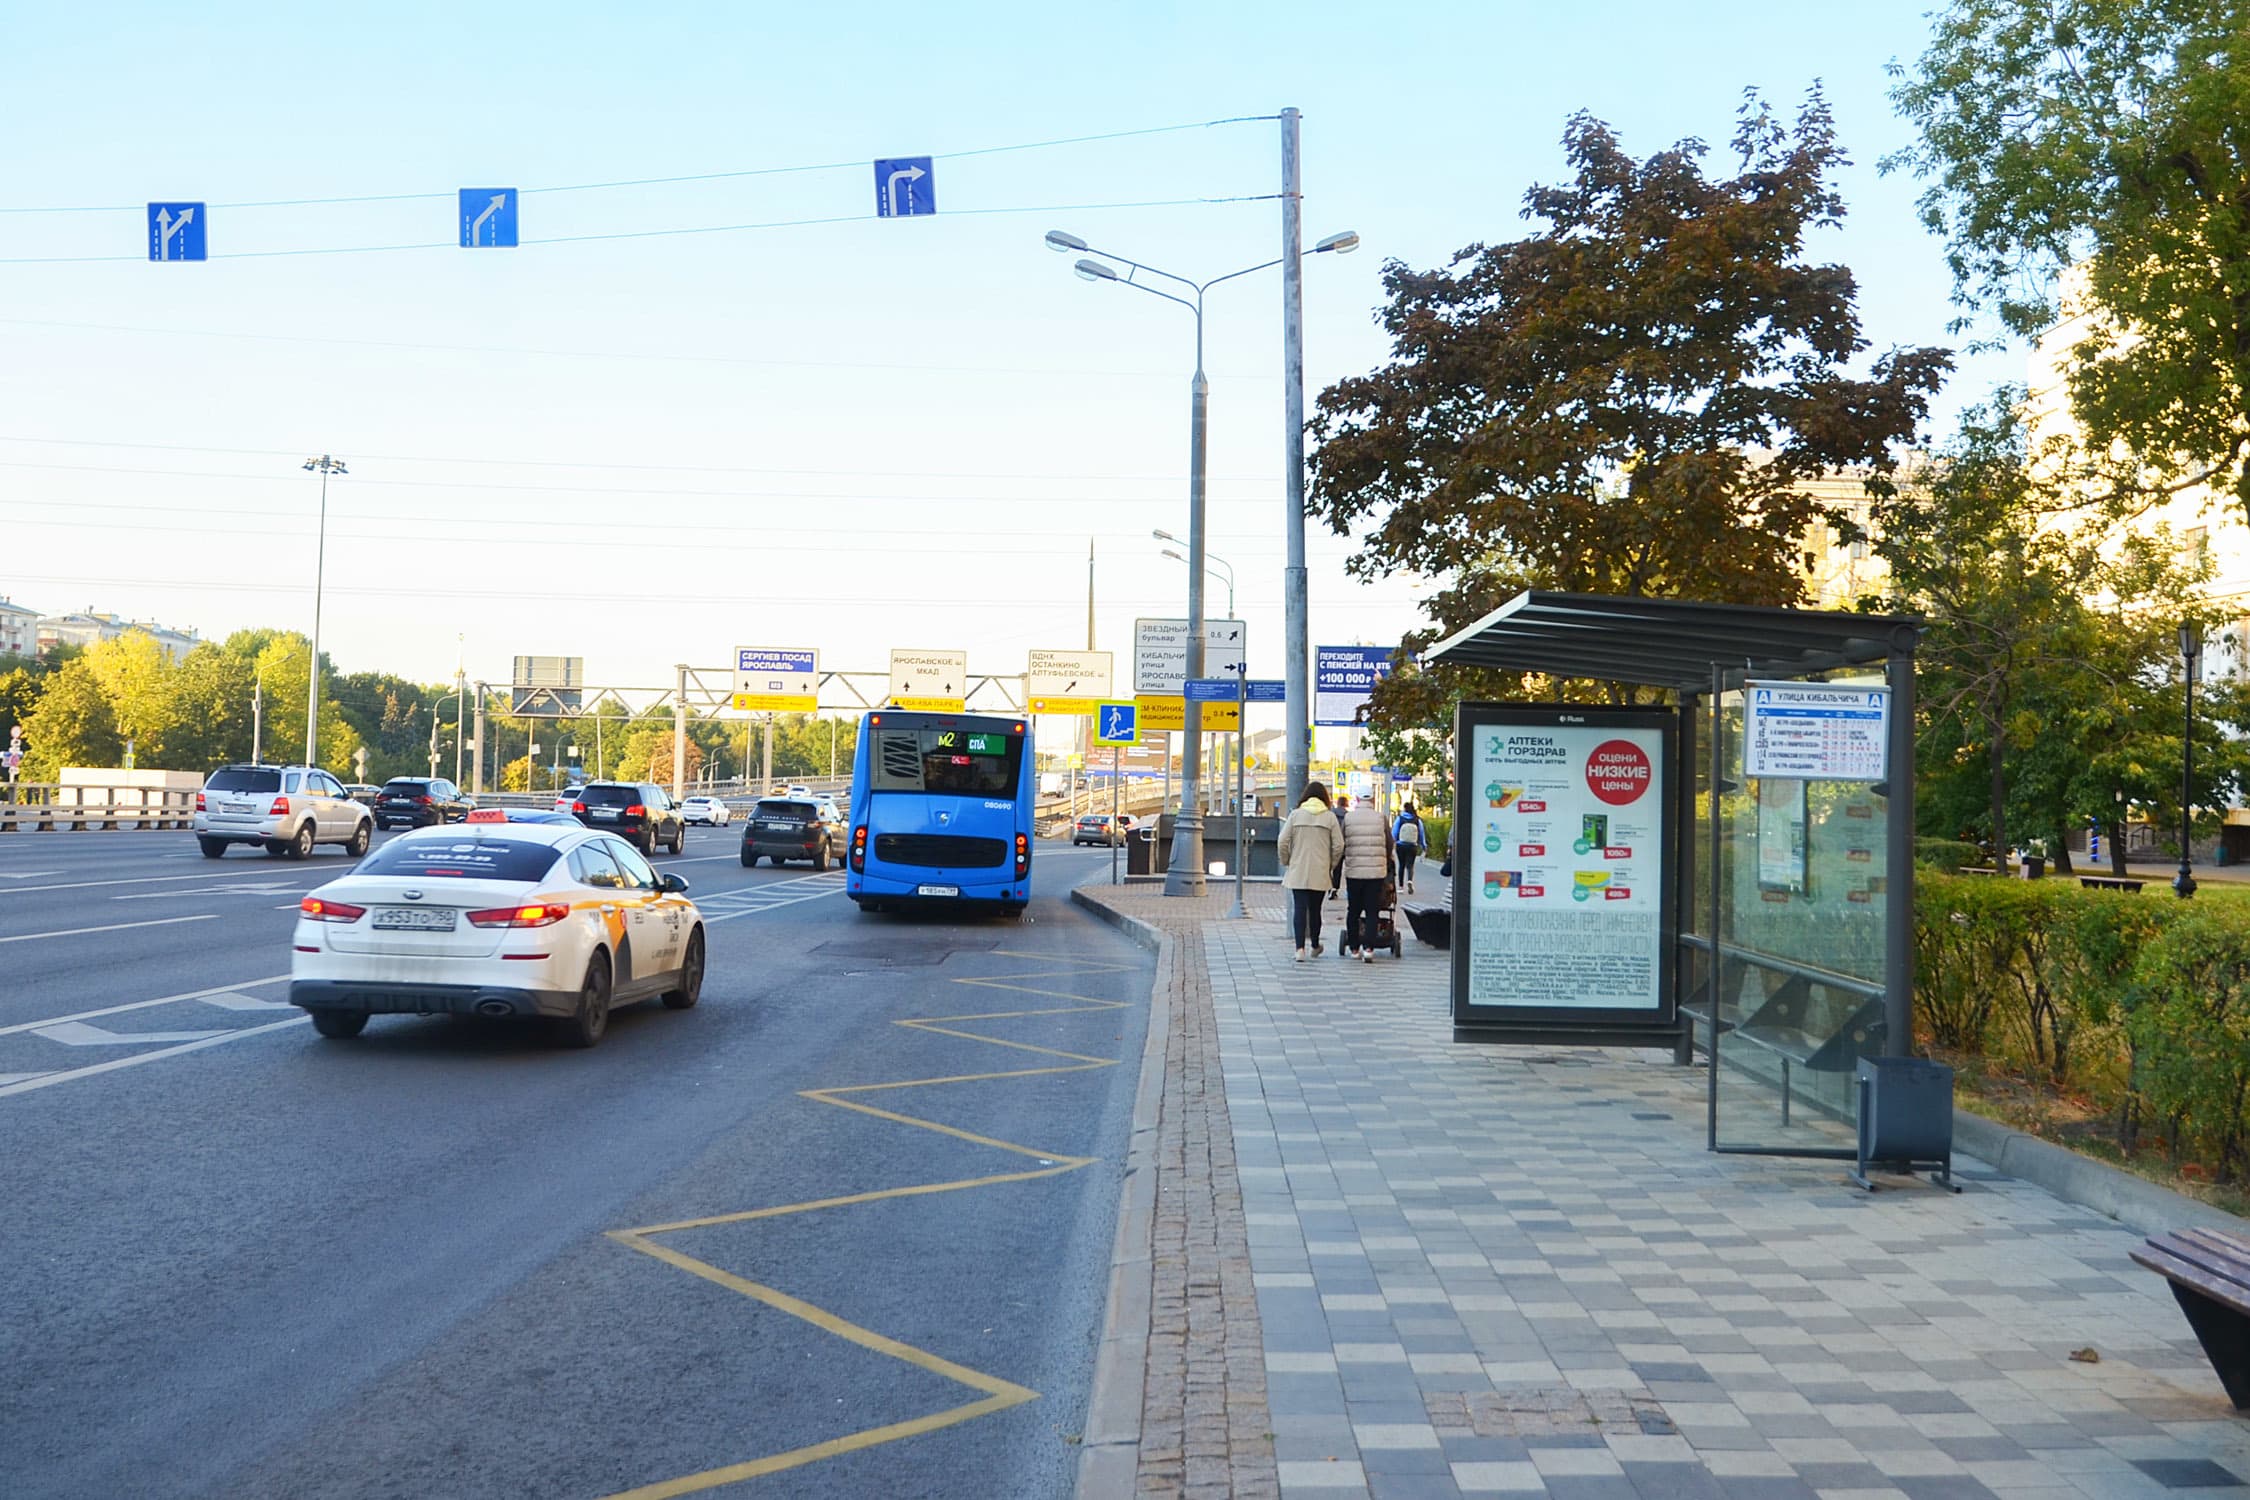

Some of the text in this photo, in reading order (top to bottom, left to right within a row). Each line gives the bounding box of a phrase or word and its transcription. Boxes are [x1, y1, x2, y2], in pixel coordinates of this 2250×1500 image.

[1142, 625, 1188, 633] ЗВЕЗДНЫЙ
[1142, 634, 1175, 642] бульвар
[742, 652, 812, 662] СЕРГИЕВ ПОСАД
[1141, 652, 1185, 660] КИБАЛЬЧИ
[1320, 652, 1364, 660] ПЕРЕХОДИТЕ
[742, 661, 794, 670] ЯРОСЛАВЛЬ
[894, 657, 952, 666] ЯРОСЛАВСКОЕ
[1326, 660, 1362, 669] ПЕНСИЕЙ
[1141, 672, 1186, 680] ЯРОСЛАВС
[1320, 673, 1344, 683] +100
[1346, 673, 1365, 683] 000
[1778, 693, 1805, 701] УЛИЦА
[1806, 694, 1859, 703] КИБАЛЬЧИЧА
[1508, 737, 1553, 746] АПТЕКИ
[1508, 747, 1566, 757] ГОРЗДРАВ
[1599, 754, 1637, 764] оцени
[1588, 765, 1648, 778] НИЗКИЕ
[1601, 782, 1634, 791] цены
